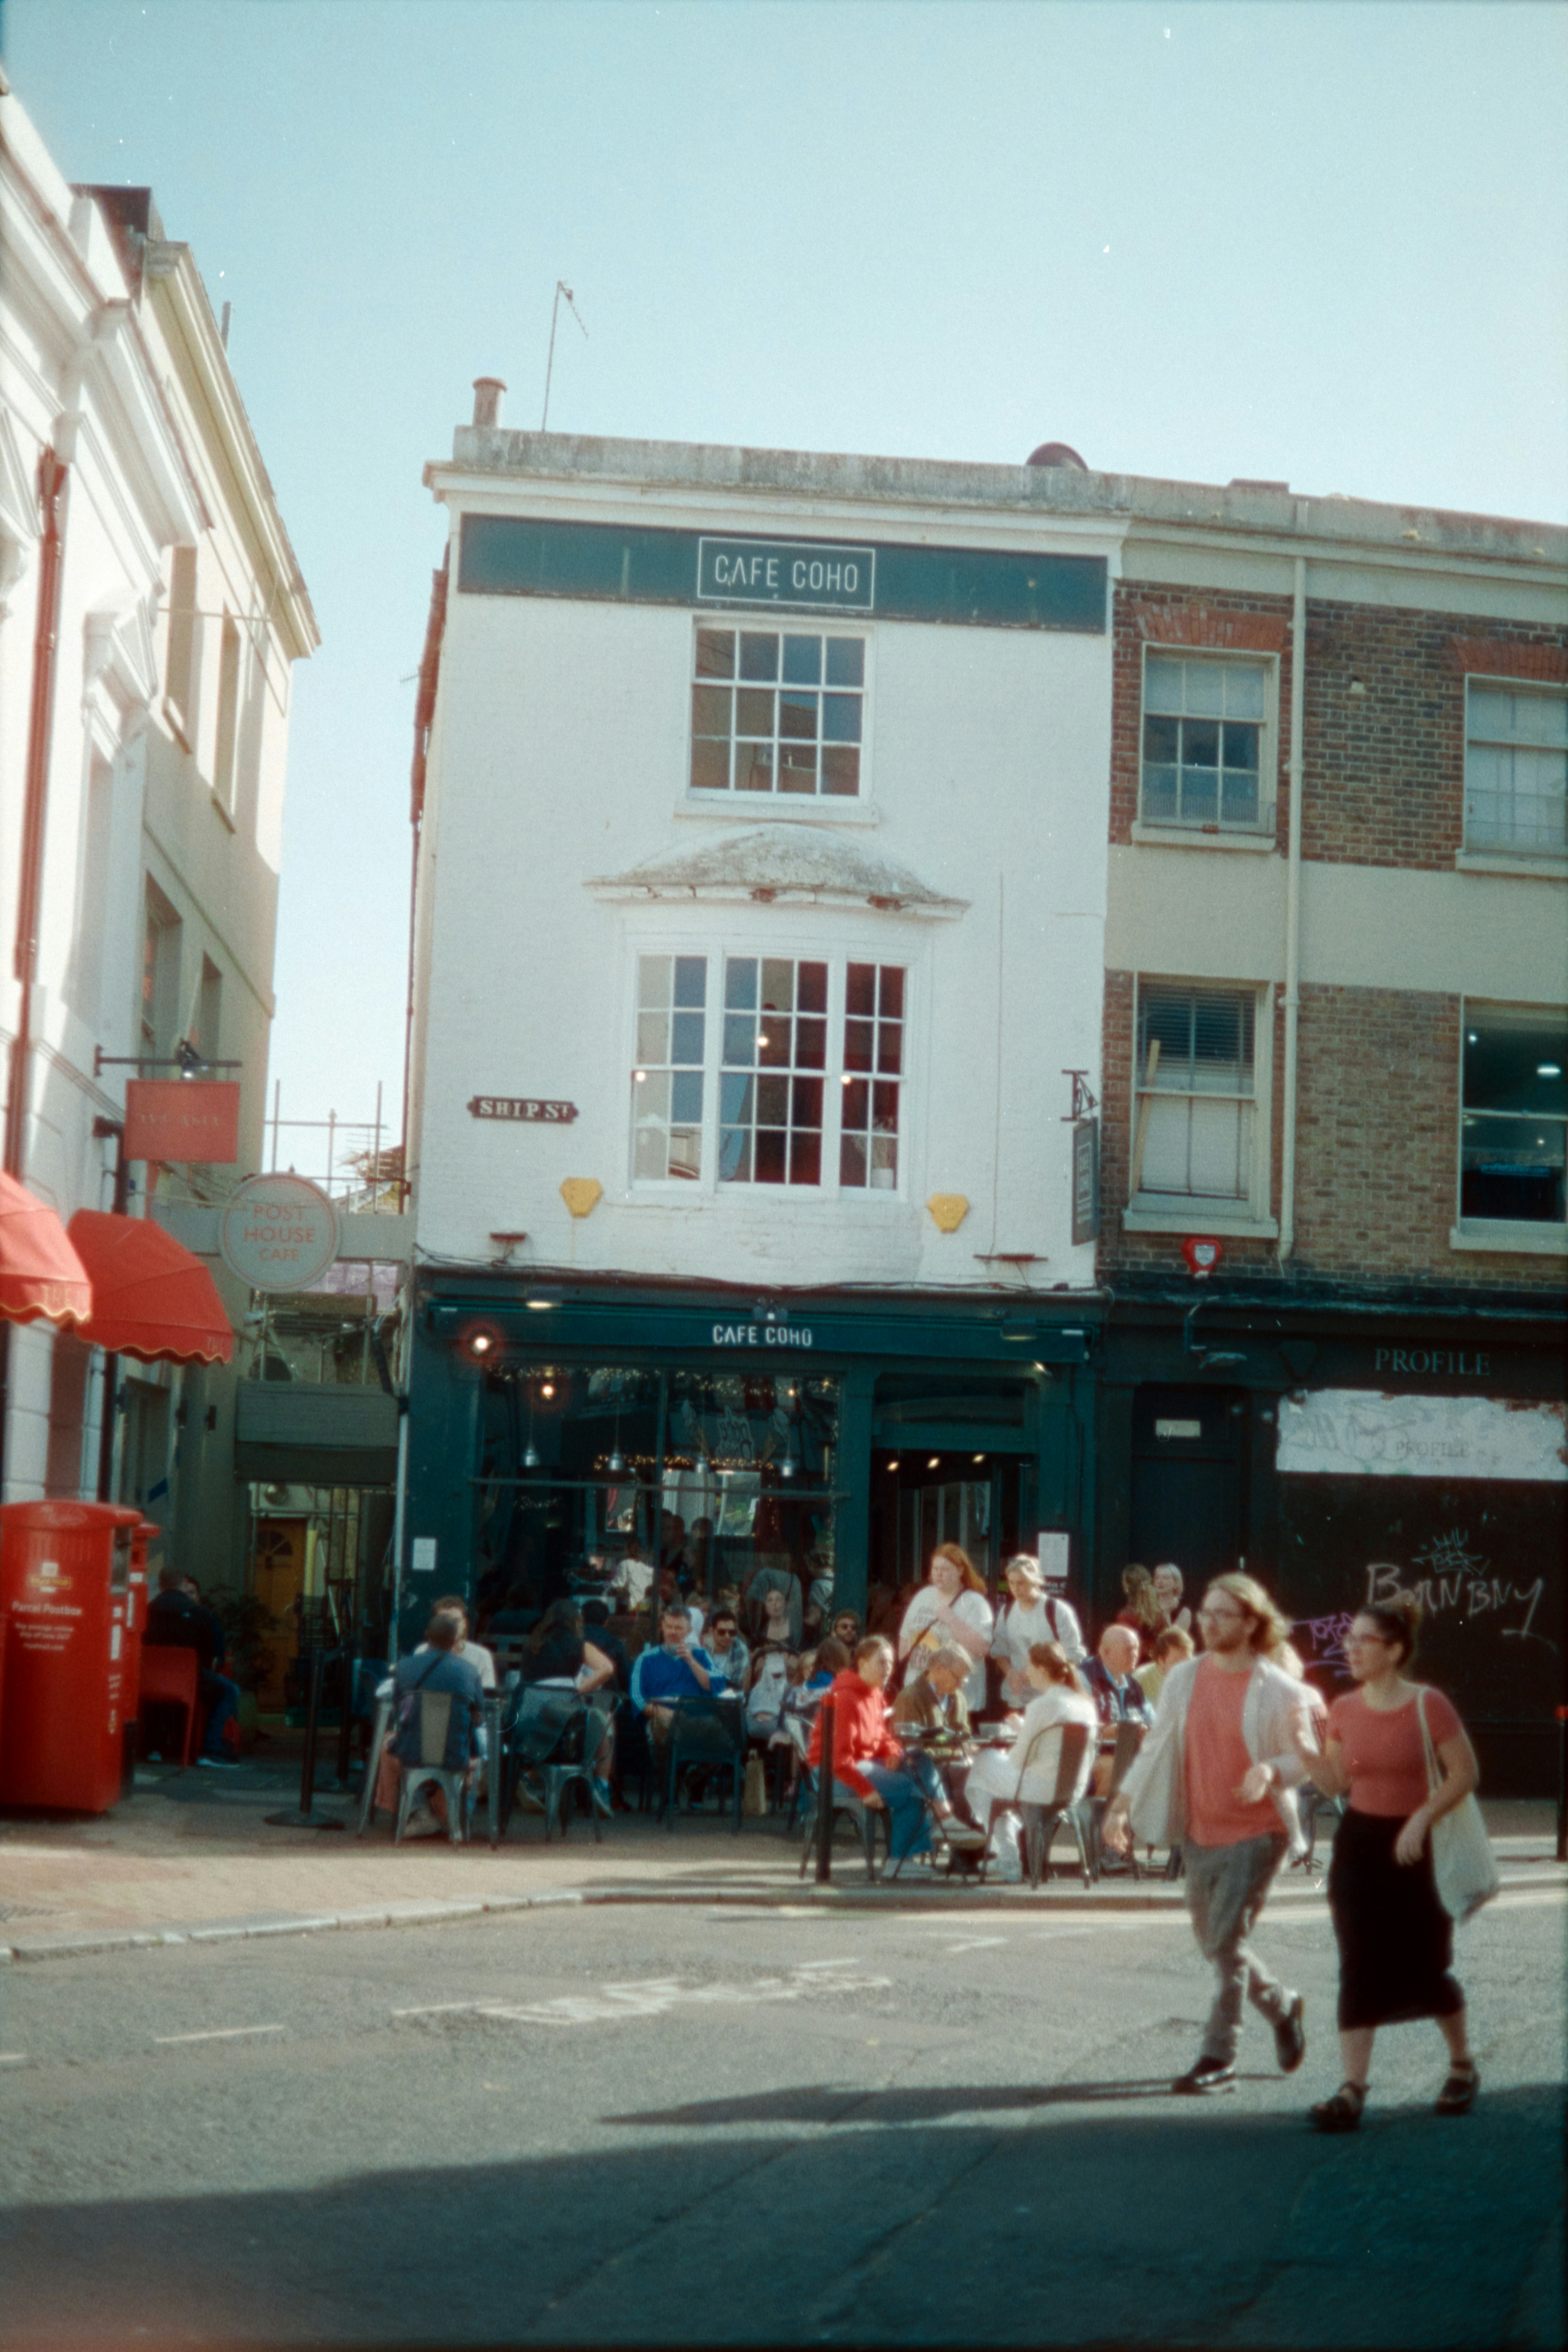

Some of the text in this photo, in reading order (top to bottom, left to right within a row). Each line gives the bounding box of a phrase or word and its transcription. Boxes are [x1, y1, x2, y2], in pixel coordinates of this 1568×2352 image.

[715, 555, 857, 592] CAFE COHO
[479, 1100, 539, 1118] SHIP
[252, 1204, 307, 1221] POST
[243, 1226, 315, 1244] HOUSE
[259, 1248, 299, 1262] CAFE
[712, 1324, 812, 1347] CAFE COHO
[1374, 1348, 1491, 1376] PROFILE
[12, 1601, 83, 1616] Parcel Postbox
